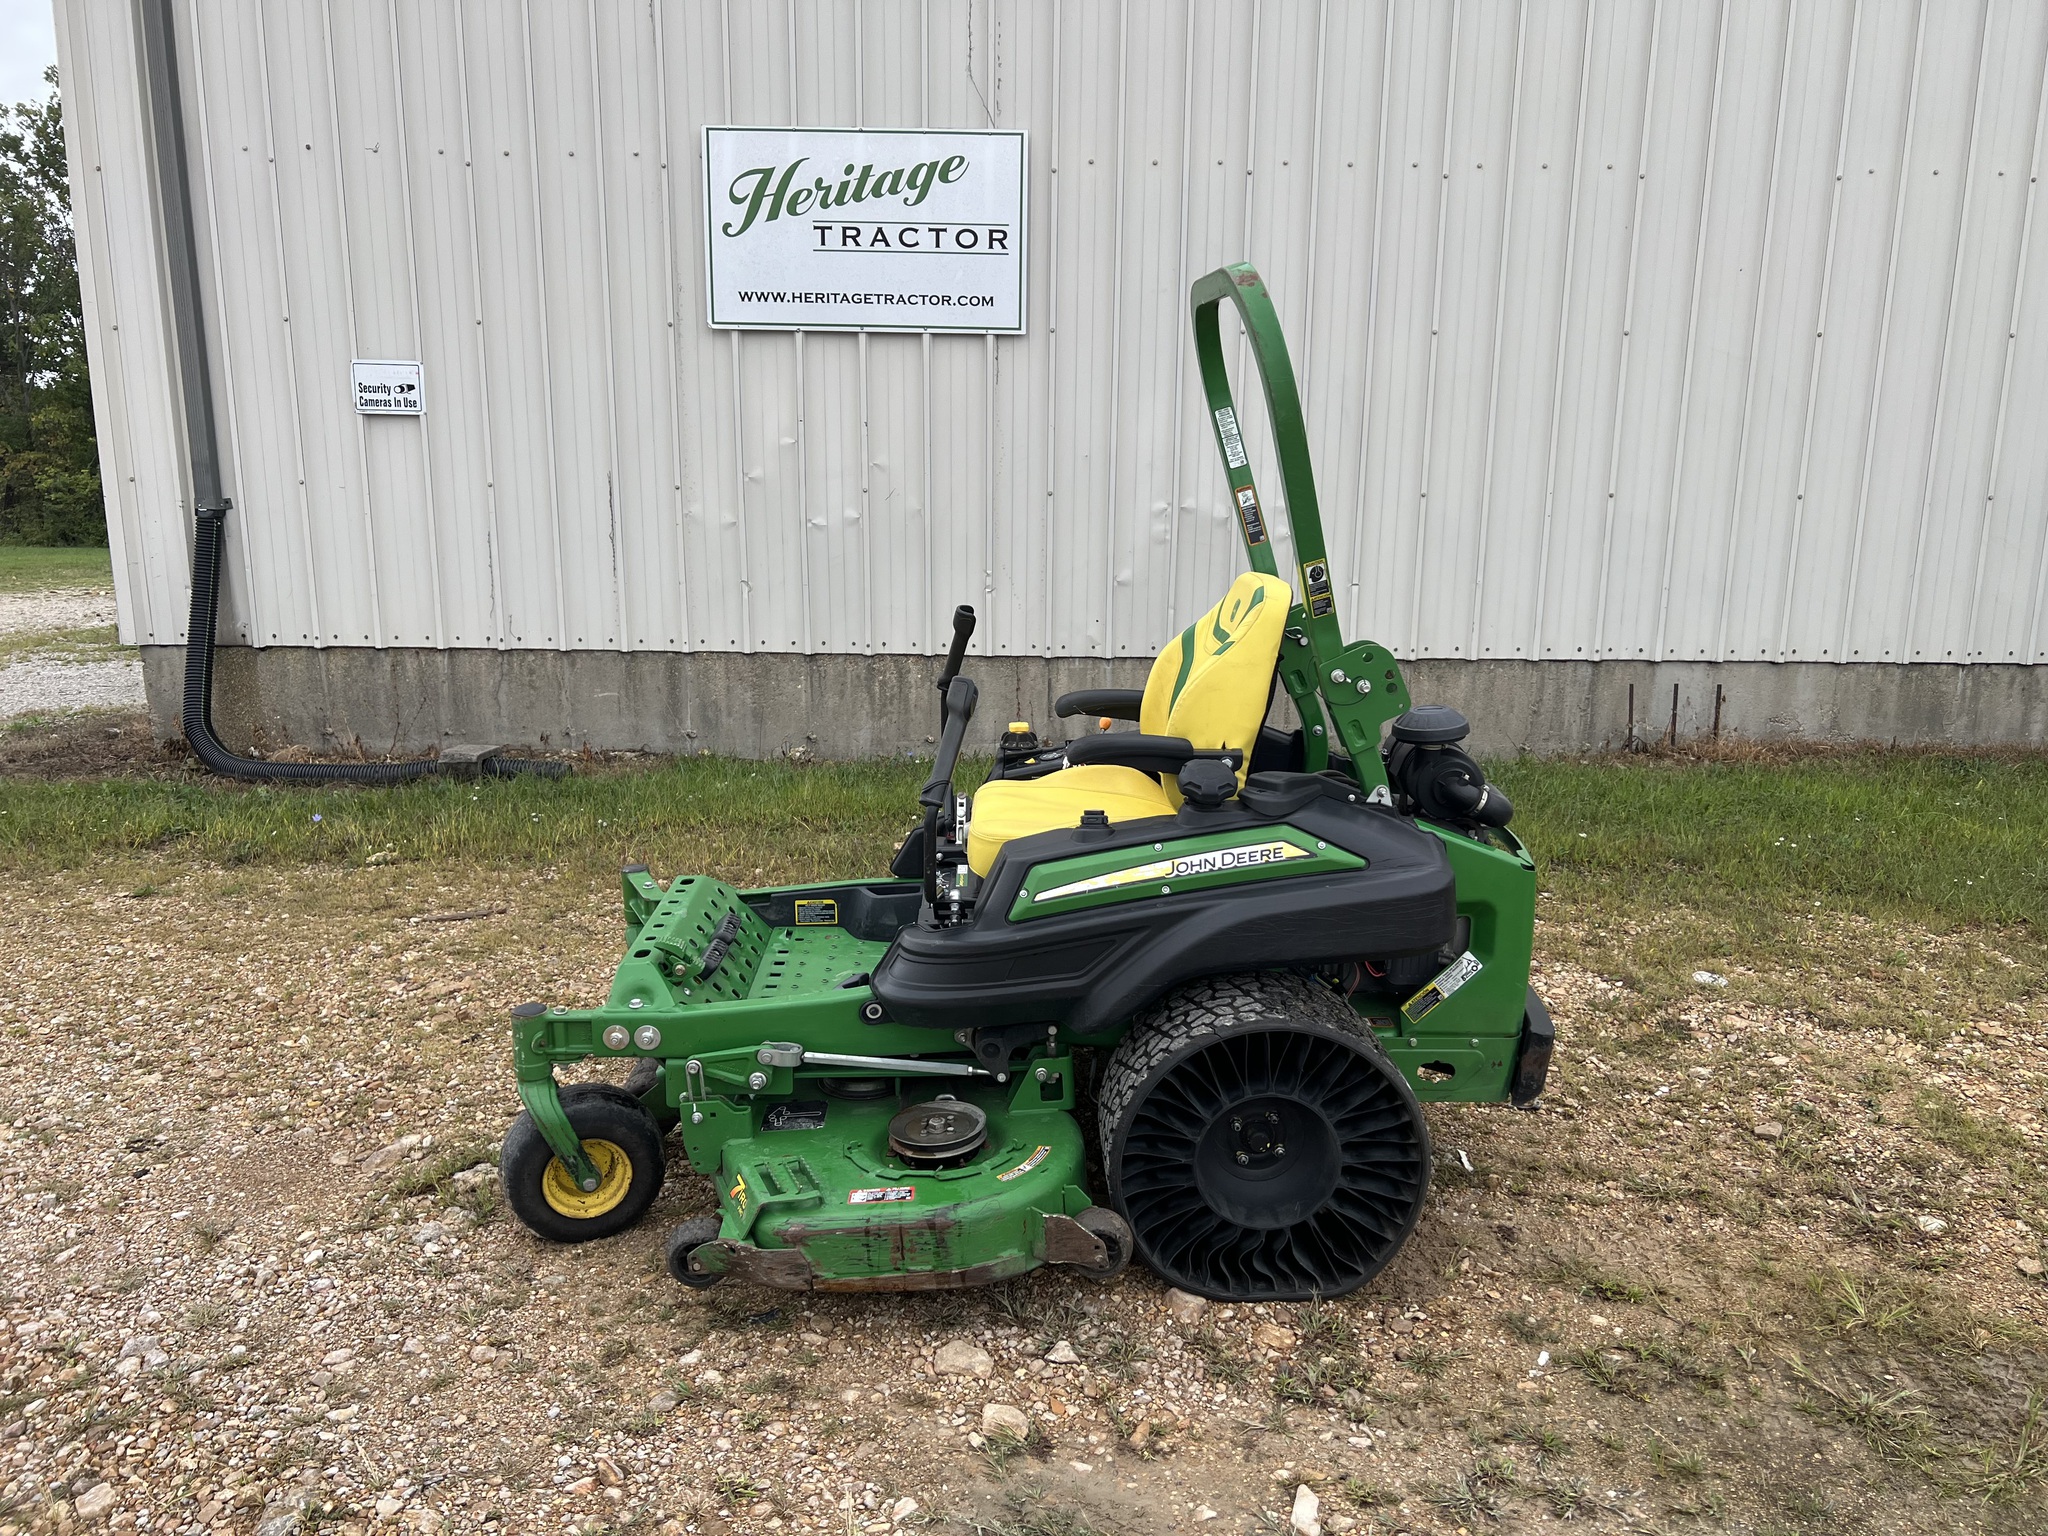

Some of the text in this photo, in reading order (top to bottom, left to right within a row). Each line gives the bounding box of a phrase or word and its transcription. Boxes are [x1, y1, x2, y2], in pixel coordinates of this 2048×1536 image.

[721, 155, 969, 237] Heritage
[813, 225, 1008, 249] TRACTOR
[738, 291, 994, 307] WWW.HERITAGETRACTOR.COM
[358, 382, 391, 396] Security
[359, 396, 417, 408] Cameras In Use
[1165, 847, 1283, 876] JOHN DEERE
